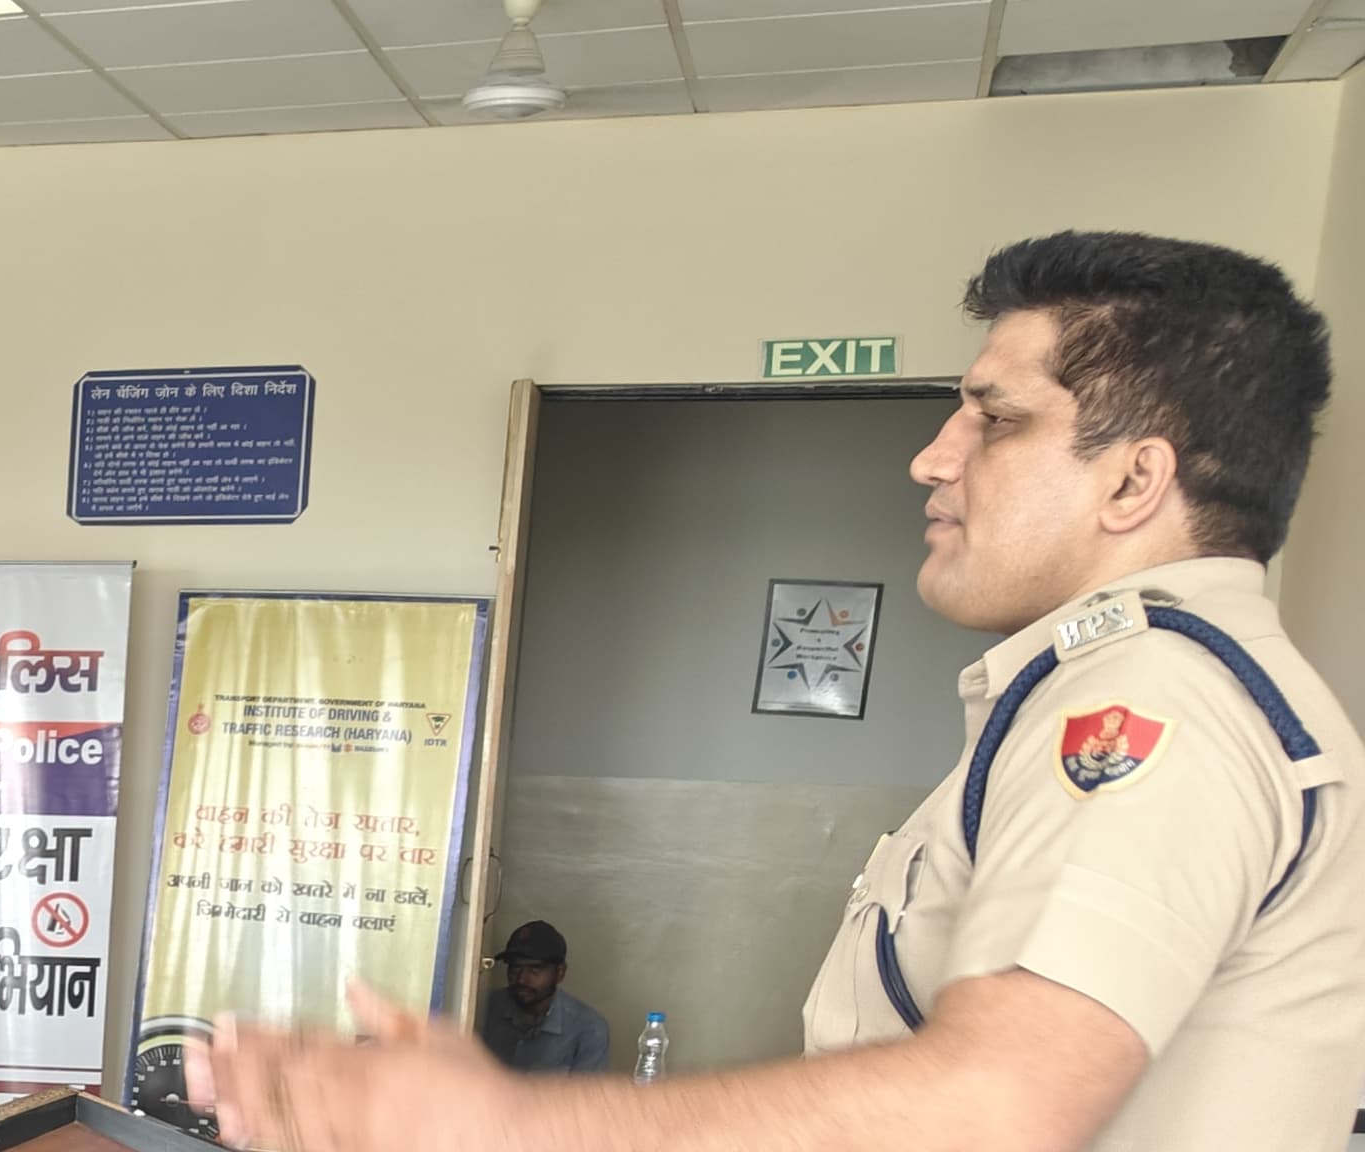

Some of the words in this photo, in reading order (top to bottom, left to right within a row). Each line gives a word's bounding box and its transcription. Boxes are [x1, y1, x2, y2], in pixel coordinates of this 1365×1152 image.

[771, 338, 894, 376] EXIT
[91, 387, 110, 400] लेन
[185, 383, 197, 398] के
[202, 382, 225, 398] लिए
[231, 382, 258, 396] दिशा
[264, 380, 297, 395] निर्देश
[243, 704, 306, 719] INSTITUTE
[308, 706, 324, 719] OF
[328, 707, 380, 722] DRIVING
[382, 711, 392, 722] &
[222, 722, 271, 736] TRAFFIC
[275, 724, 340, 739] RESEARCH
[343, 728, 412, 745] (HARYANA)
[196, 803, 250, 825] वाहन
[260, 803, 292, 826] की
[288, 838, 347, 864] सुरक्षा
[359, 843, 387, 862] पर
[399, 847, 438, 865] वार
[167, 871, 211, 890] अपनी
[219, 877, 252, 893] जान
[261, 876, 283, 896] को
[292, 880, 334, 899] खतरे
[342, 882, 356, 900] में
[364, 887, 386, 902] ना
[276, 905, 290, 923] से
[298, 911, 342, 928] वाहन
